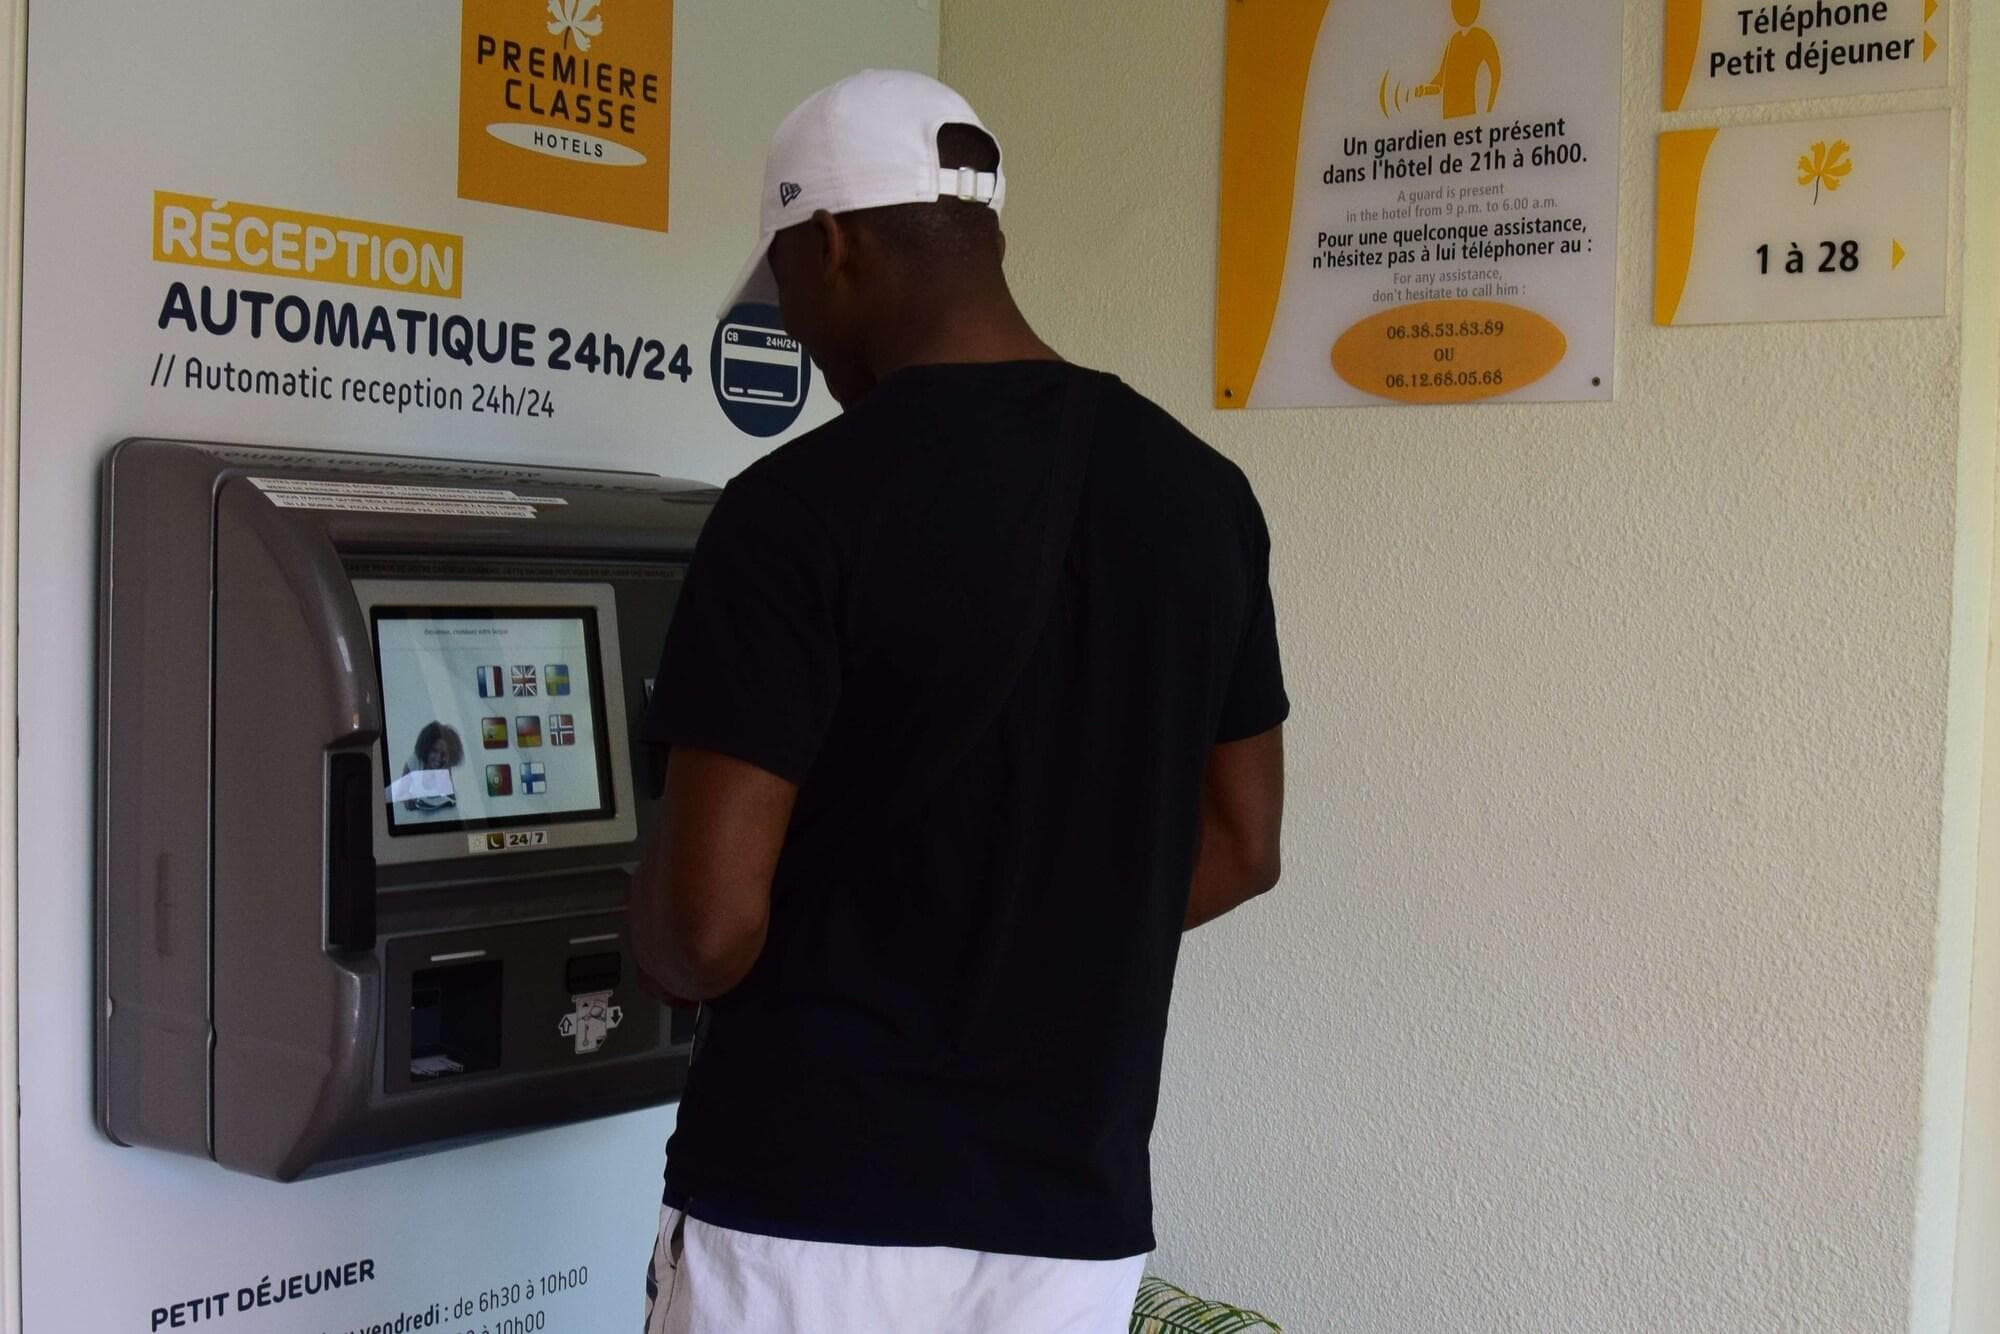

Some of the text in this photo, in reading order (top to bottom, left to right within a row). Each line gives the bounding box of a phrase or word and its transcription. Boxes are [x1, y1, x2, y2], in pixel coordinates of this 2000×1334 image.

[1738, 0, 1888, 37] Téléphone
[477, 34, 658, 104] PREMIERE
[1710, 38, 1915, 77] Petit déjeuner
[505, 79, 636, 134] CLASSE
[534, 131, 603, 158] HOTELS
[1343, 118, 1565, 159] Un gardien est présent
[1323, 143, 1588, 185] dans l'hôtel de 21h à 6h00.
[1397, 183, 1504, 204] A guard is present
[1346, 197, 1558, 222] in the hotel from 9 p.m. to 6.00 a.m.
[162, 199, 453, 290] RÉCEPTION
[1318, 217, 1588, 248] Pour une quelconque assistance,
[1312, 248, 1383, 269] n'hésitez
[1388, 249, 1415, 268] pas
[1420, 243, 1431, 262] à
[1436, 243, 1456, 261] lui
[1461, 240, 1555, 261] téléphoner
[1560, 239, 1582, 253] au
[1756, 240, 1859, 274] 1 à 28
[1372, 288, 1401, 303] don't
[1405, 287, 1452, 301] hesitate
[1456, 288, 1468, 298] to
[1472, 285, 1492, 297] call
[1496, 284, 1518, 297] him
[1393, 269, 1503, 287] For any assistance,
[158, 281, 693, 384] AUTOMATIQUE 24h/24
[726, 330, 797, 350] CB 24H/24
[1387, 320, 1504, 340] 06.38.53.83.89
[1433, 348, 1454, 362] OU
[185, 357, 333, 400] Automatic
[341, 376, 462, 414] reception
[471, 383, 554, 418] 24h/24
[1386, 368, 1503, 388] 06.12.68.05.68
[509, 832, 544, 846] 24/7
[151, 1258, 375, 1333] PETIT DÉJEUNER
[453, 1297, 473, 1319] de
[479, 1284, 520, 1313] 6h30
[526, 1279, 534, 1299] à
[540, 1266, 588, 1297] 10h00
[496, 1310, 545, 1334] 10h00
